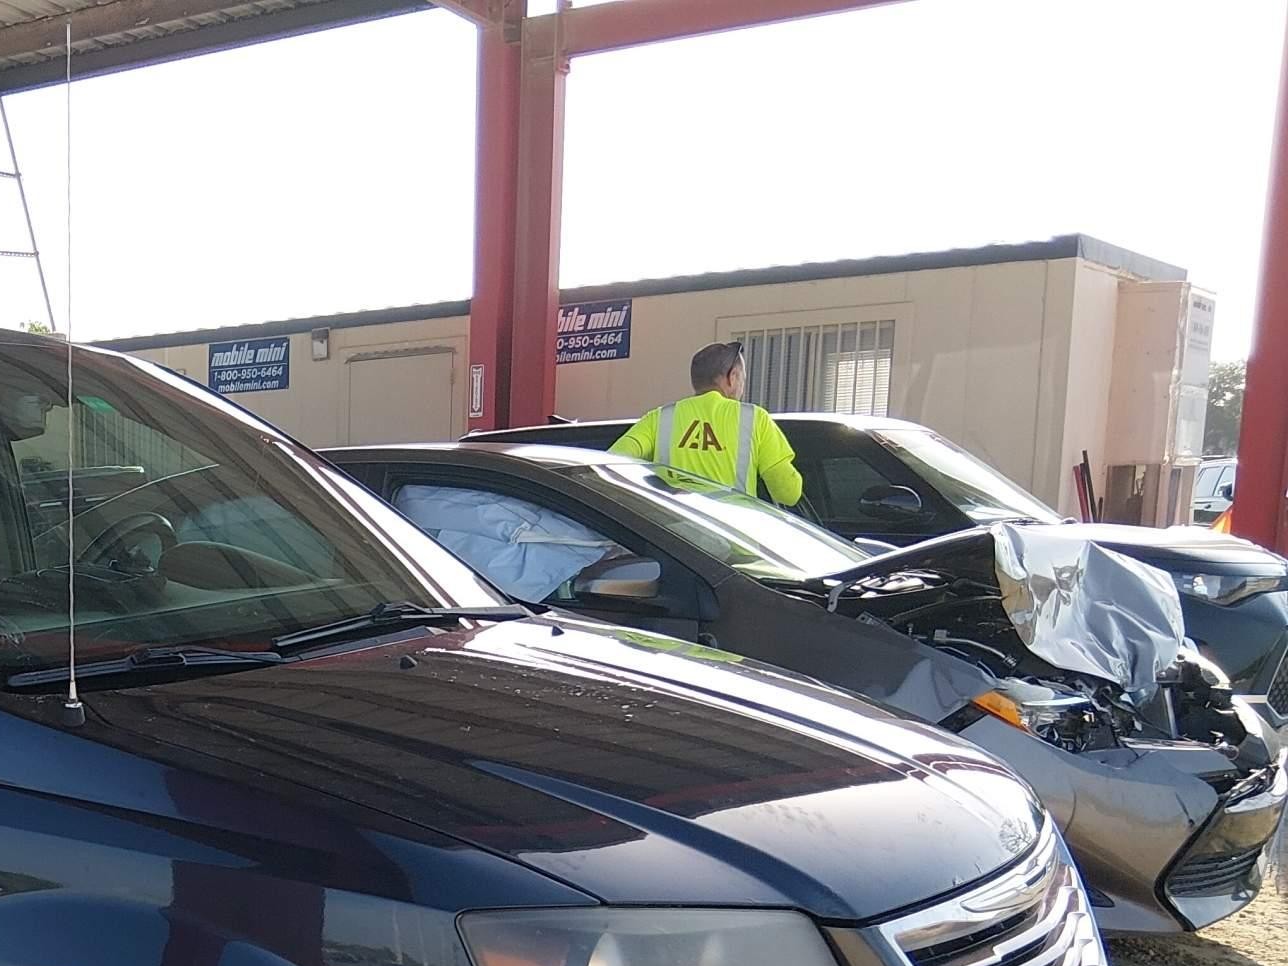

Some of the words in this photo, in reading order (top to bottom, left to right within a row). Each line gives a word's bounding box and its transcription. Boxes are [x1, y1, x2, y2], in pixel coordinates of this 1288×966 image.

[556, 307, 587, 333] bile
[587, 305, 628, 330] mini
[556, 332, 623, 350] 0-950-6464
[211, 343, 255, 367] mobile
[255, 342, 288, 363] mini
[556, 348, 617, 363] ilemini.com
[214, 366, 283, 382] 1-800-950-6464
[218, 380, 279, 393] mobilemini.com
